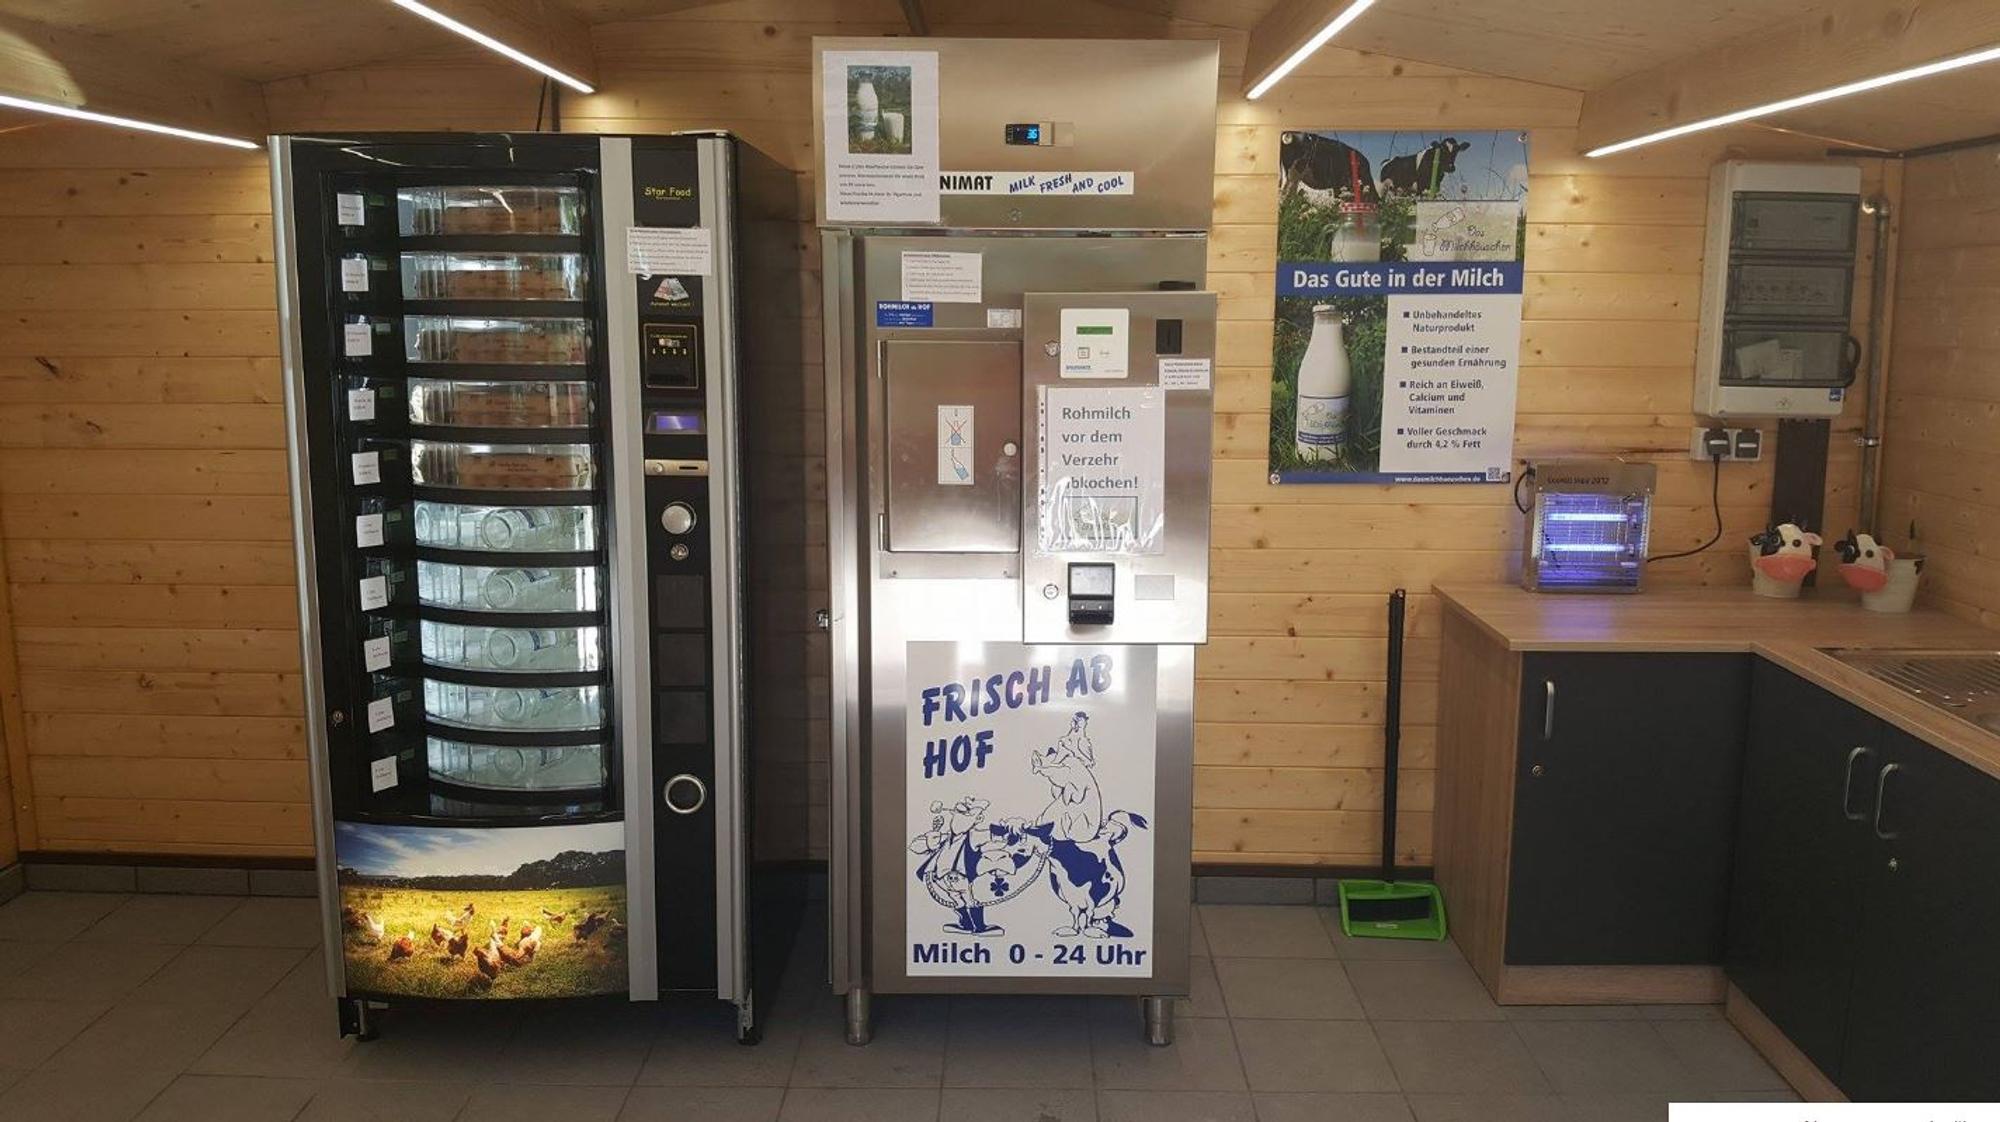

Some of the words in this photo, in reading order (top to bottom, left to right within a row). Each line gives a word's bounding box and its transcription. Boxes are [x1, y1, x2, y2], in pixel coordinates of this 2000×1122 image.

[1009, 175, 1035, 194] MILK
[1039, 173, 1072, 193] FRESH
[1072, 177, 1094, 193] AND
[1097, 175, 1124, 193] COOL
[644, 187, 666, 196] Star
[670, 187, 691, 197] Food
[1293, 270, 1329, 288] Das
[1335, 270, 1382, 288] Gute
[1388, 268, 1405, 287] in
[1412, 268, 1445, 287] der
[1451, 268, 1504, 287] Milch
[1412, 310, 1482, 319] Unbehandeltes
[1412, 323, 1475, 333] Naturprodukt
[1411, 345, 1463, 354] Bestandteil
[1465, 345, 1489, 353] einer
[1411, 359, 1455, 369] gesunden
[1459, 358, 1507, 369] Ernährung
[1409, 380, 1434, 389] Reich
[1436, 381, 1448, 389] an
[1450, 379, 1484, 390] Eiweiß,
[1409, 393, 1445, 401] Calcium
[1447, 392, 1465, 401] und
[1062, 406, 1131, 420] Rohmilch
[1408, 406, 1455, 414] Vitaminen
[1062, 433, 1086, 443] vor
[1090, 430, 1122, 443] dem
[1407, 427, 1433, 436] Voller
[1435, 427, 1487, 436] Geschmack
[1406, 440, 1432, 448] durch
[1435, 440, 1449, 449] 4,2
[1451, 440, 1460, 448] %
[1463, 440, 1481, 448] Fett
[1062, 453, 1119, 466] Verzehr
[921, 665, 1051, 726] FRISCH
[1066, 654, 1114, 698] AB
[923, 730, 994, 779] HOF
[912, 943, 991, 964] Milch
[1009, 945, 1025, 964] 0
[1052, 945, 1086, 965] 24
[1096, 944, 1146, 966] Uhr
